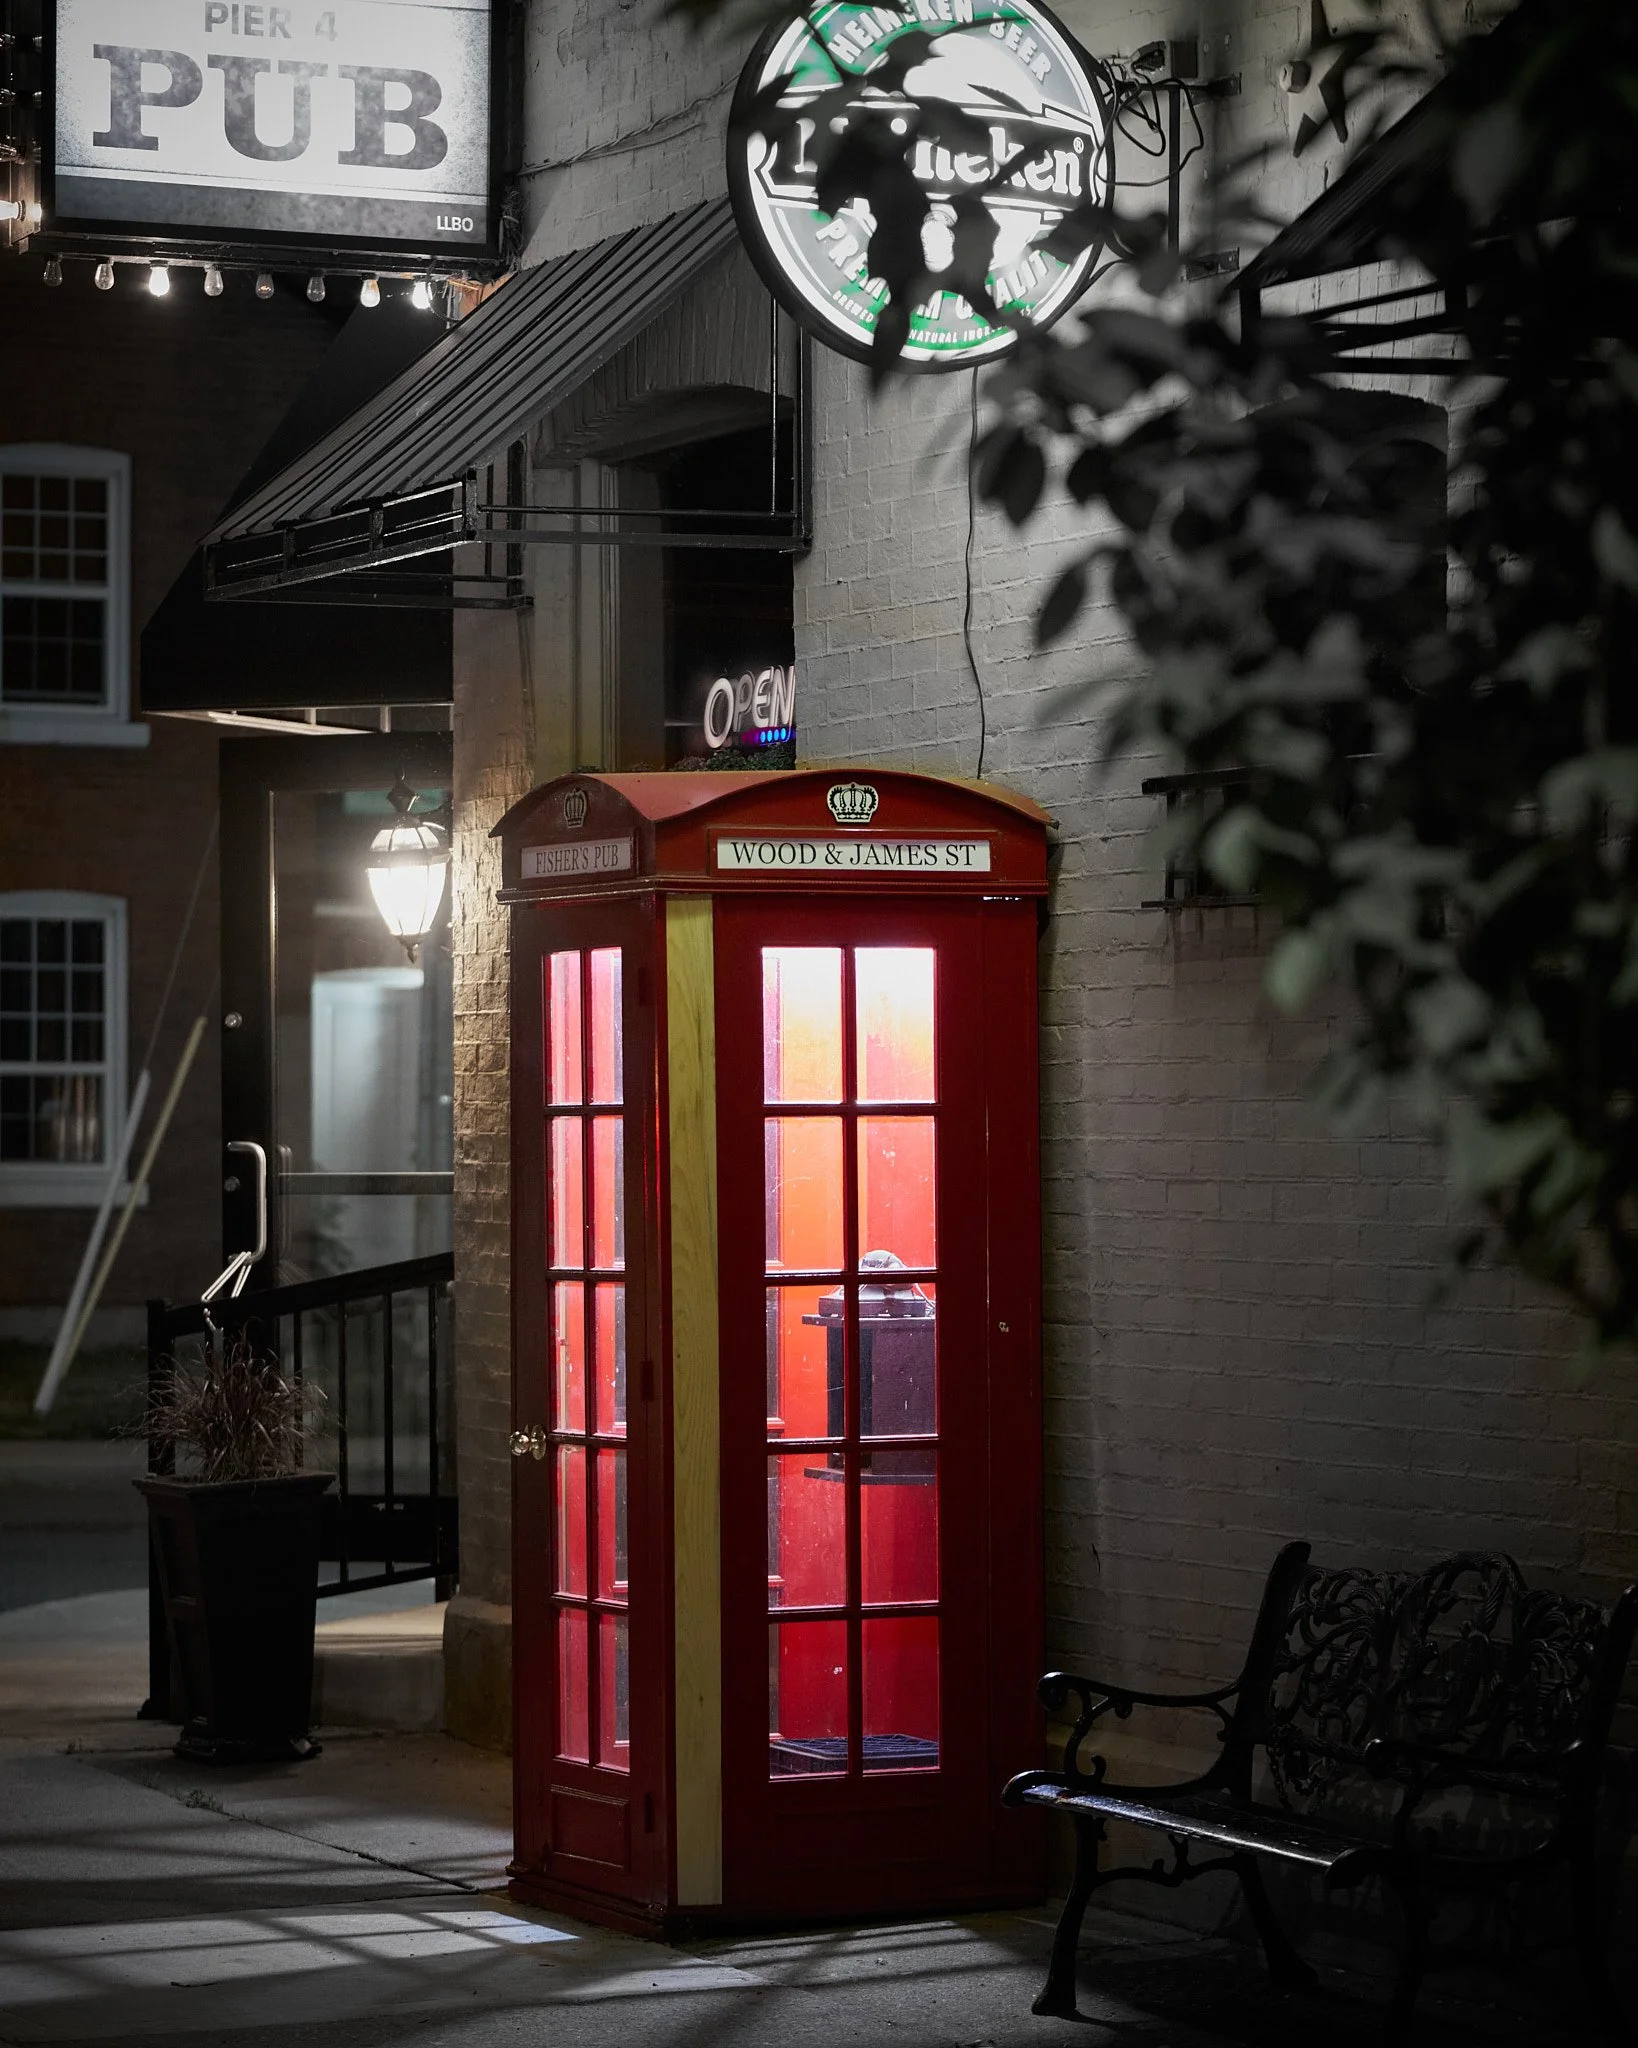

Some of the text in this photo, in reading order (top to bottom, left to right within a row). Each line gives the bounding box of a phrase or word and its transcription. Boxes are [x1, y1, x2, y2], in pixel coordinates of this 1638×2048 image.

[204, 1, 338, 42] PIER 4
[989, 12, 1051, 82] BEER
[93, 43, 449, 171] PUB
[794, 117, 1082, 196] neken
[436, 215, 474, 233] LLBO
[832, 290, 874, 323] BREWED
[909, 329, 957, 344] NATURAL
[704, 665, 795, 748] OPEN
[535, 844, 619, 874] FISHER'S PUB
[731, 841, 976, 867] WOOD & JAMES ST
